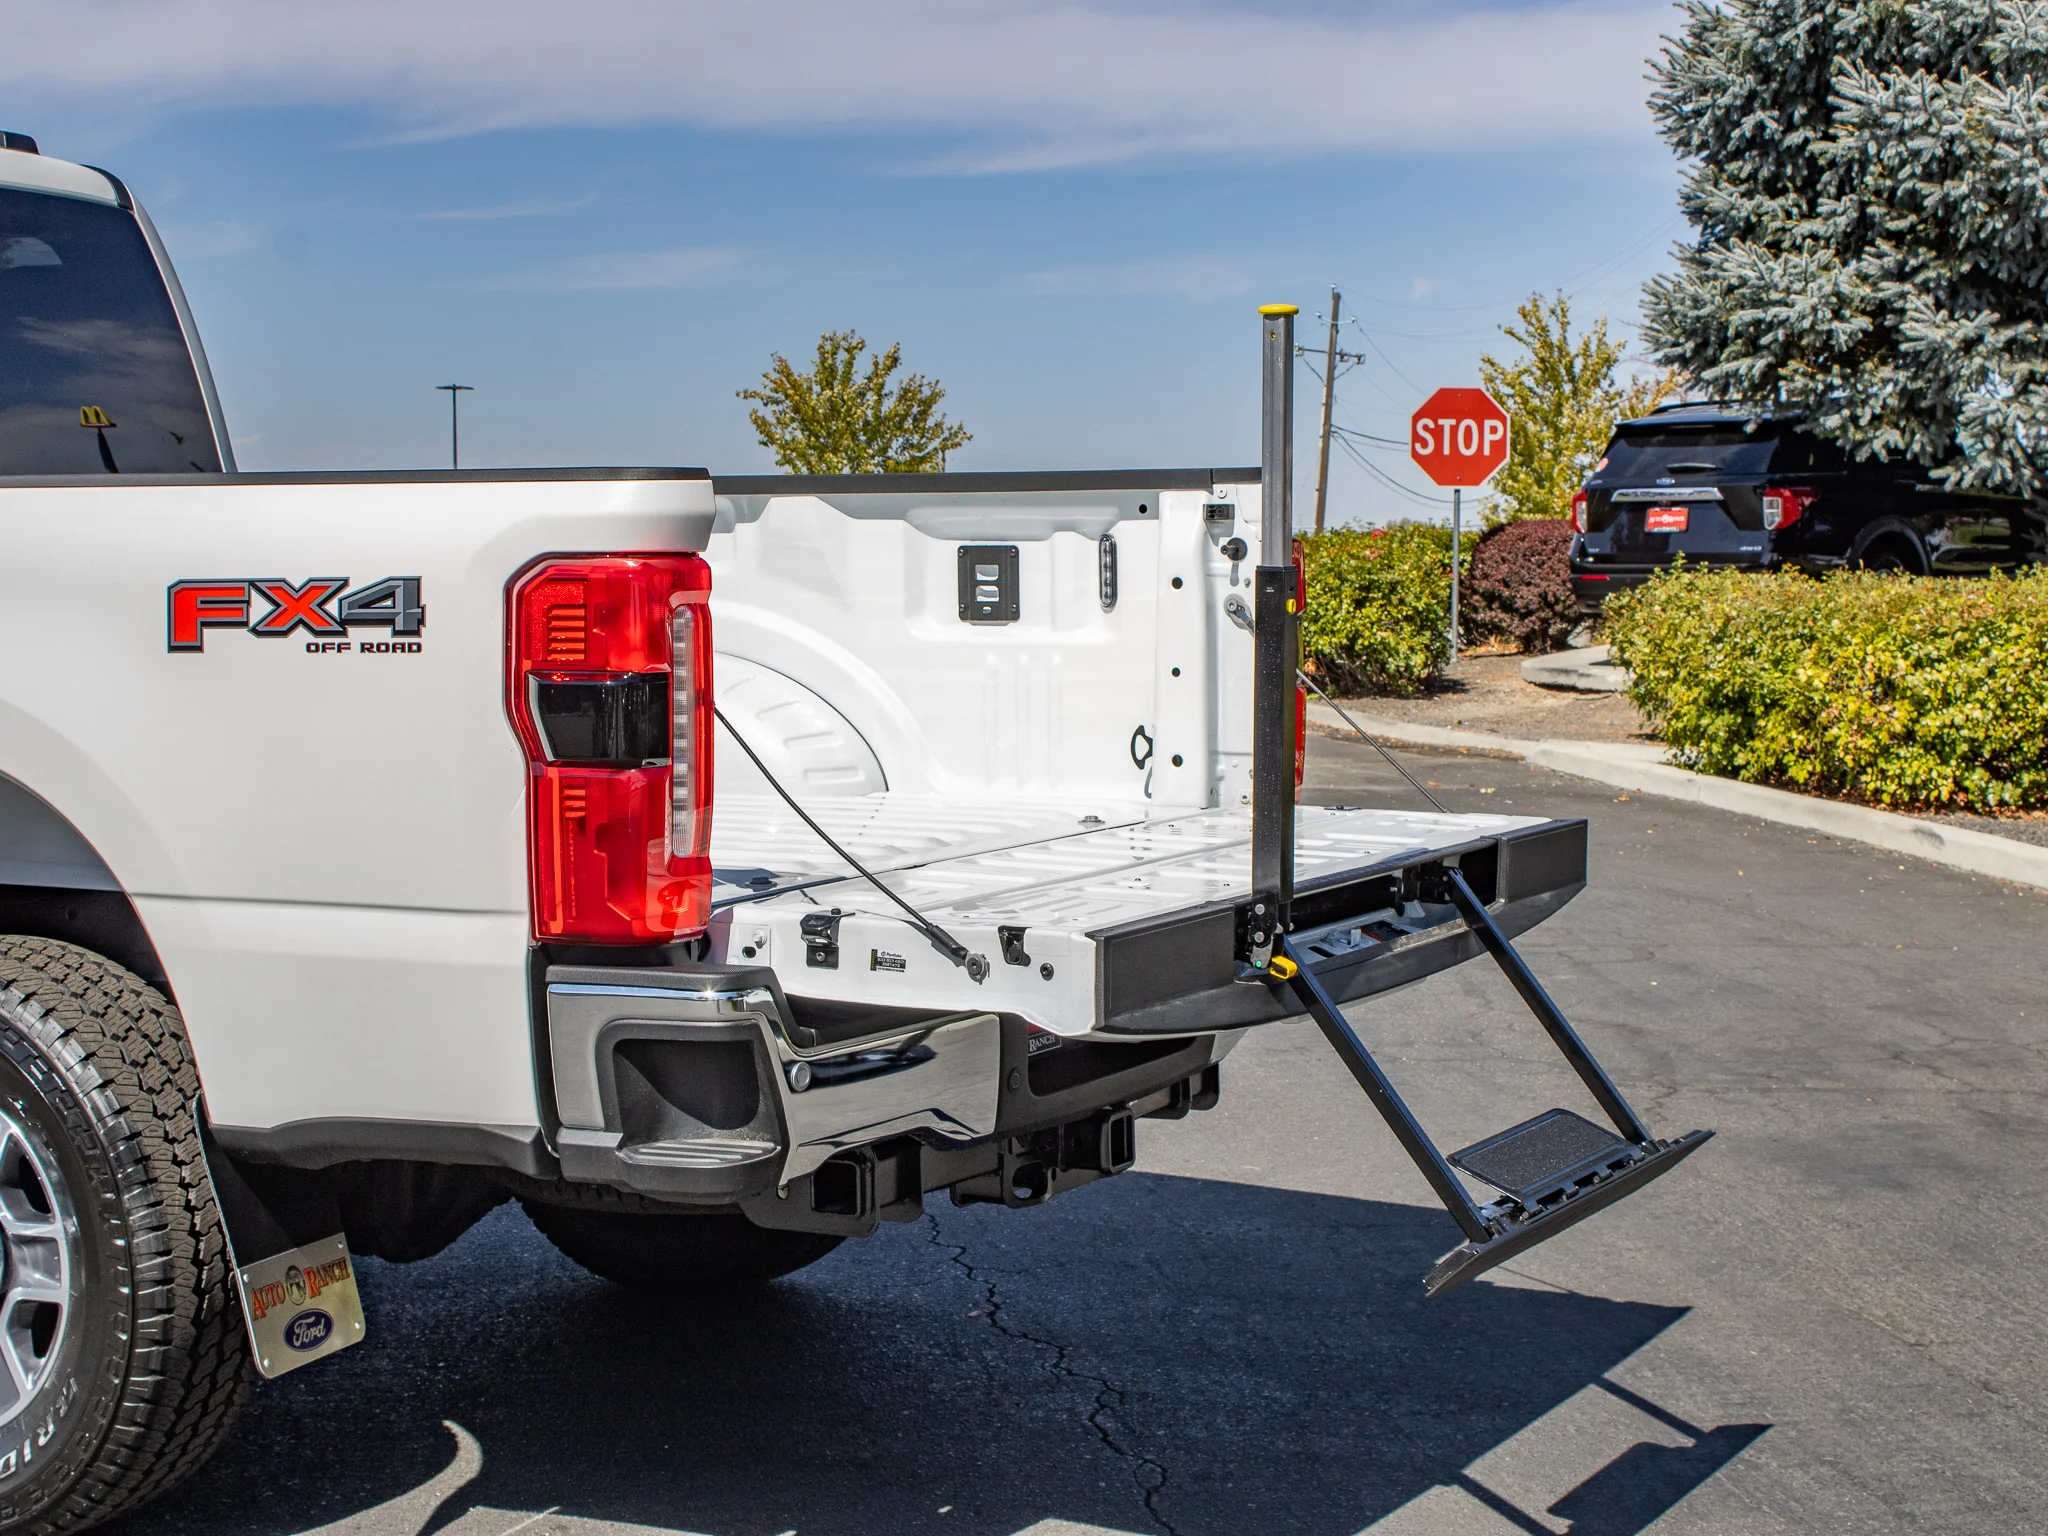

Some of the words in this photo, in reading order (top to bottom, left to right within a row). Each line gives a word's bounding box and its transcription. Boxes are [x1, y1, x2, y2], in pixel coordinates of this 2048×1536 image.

[1414, 418, 1504, 456] STOP
[167, 576, 426, 653] FX4
[306, 642, 351, 653] OFF
[360, 642, 422, 653] ROAD
[1029, 1034, 1055, 1051] RANCH
[251, 1280, 286, 1321] AUTO
[304, 1256, 351, 1299] RANCH
[293, 1316, 327, 1347] Ford
